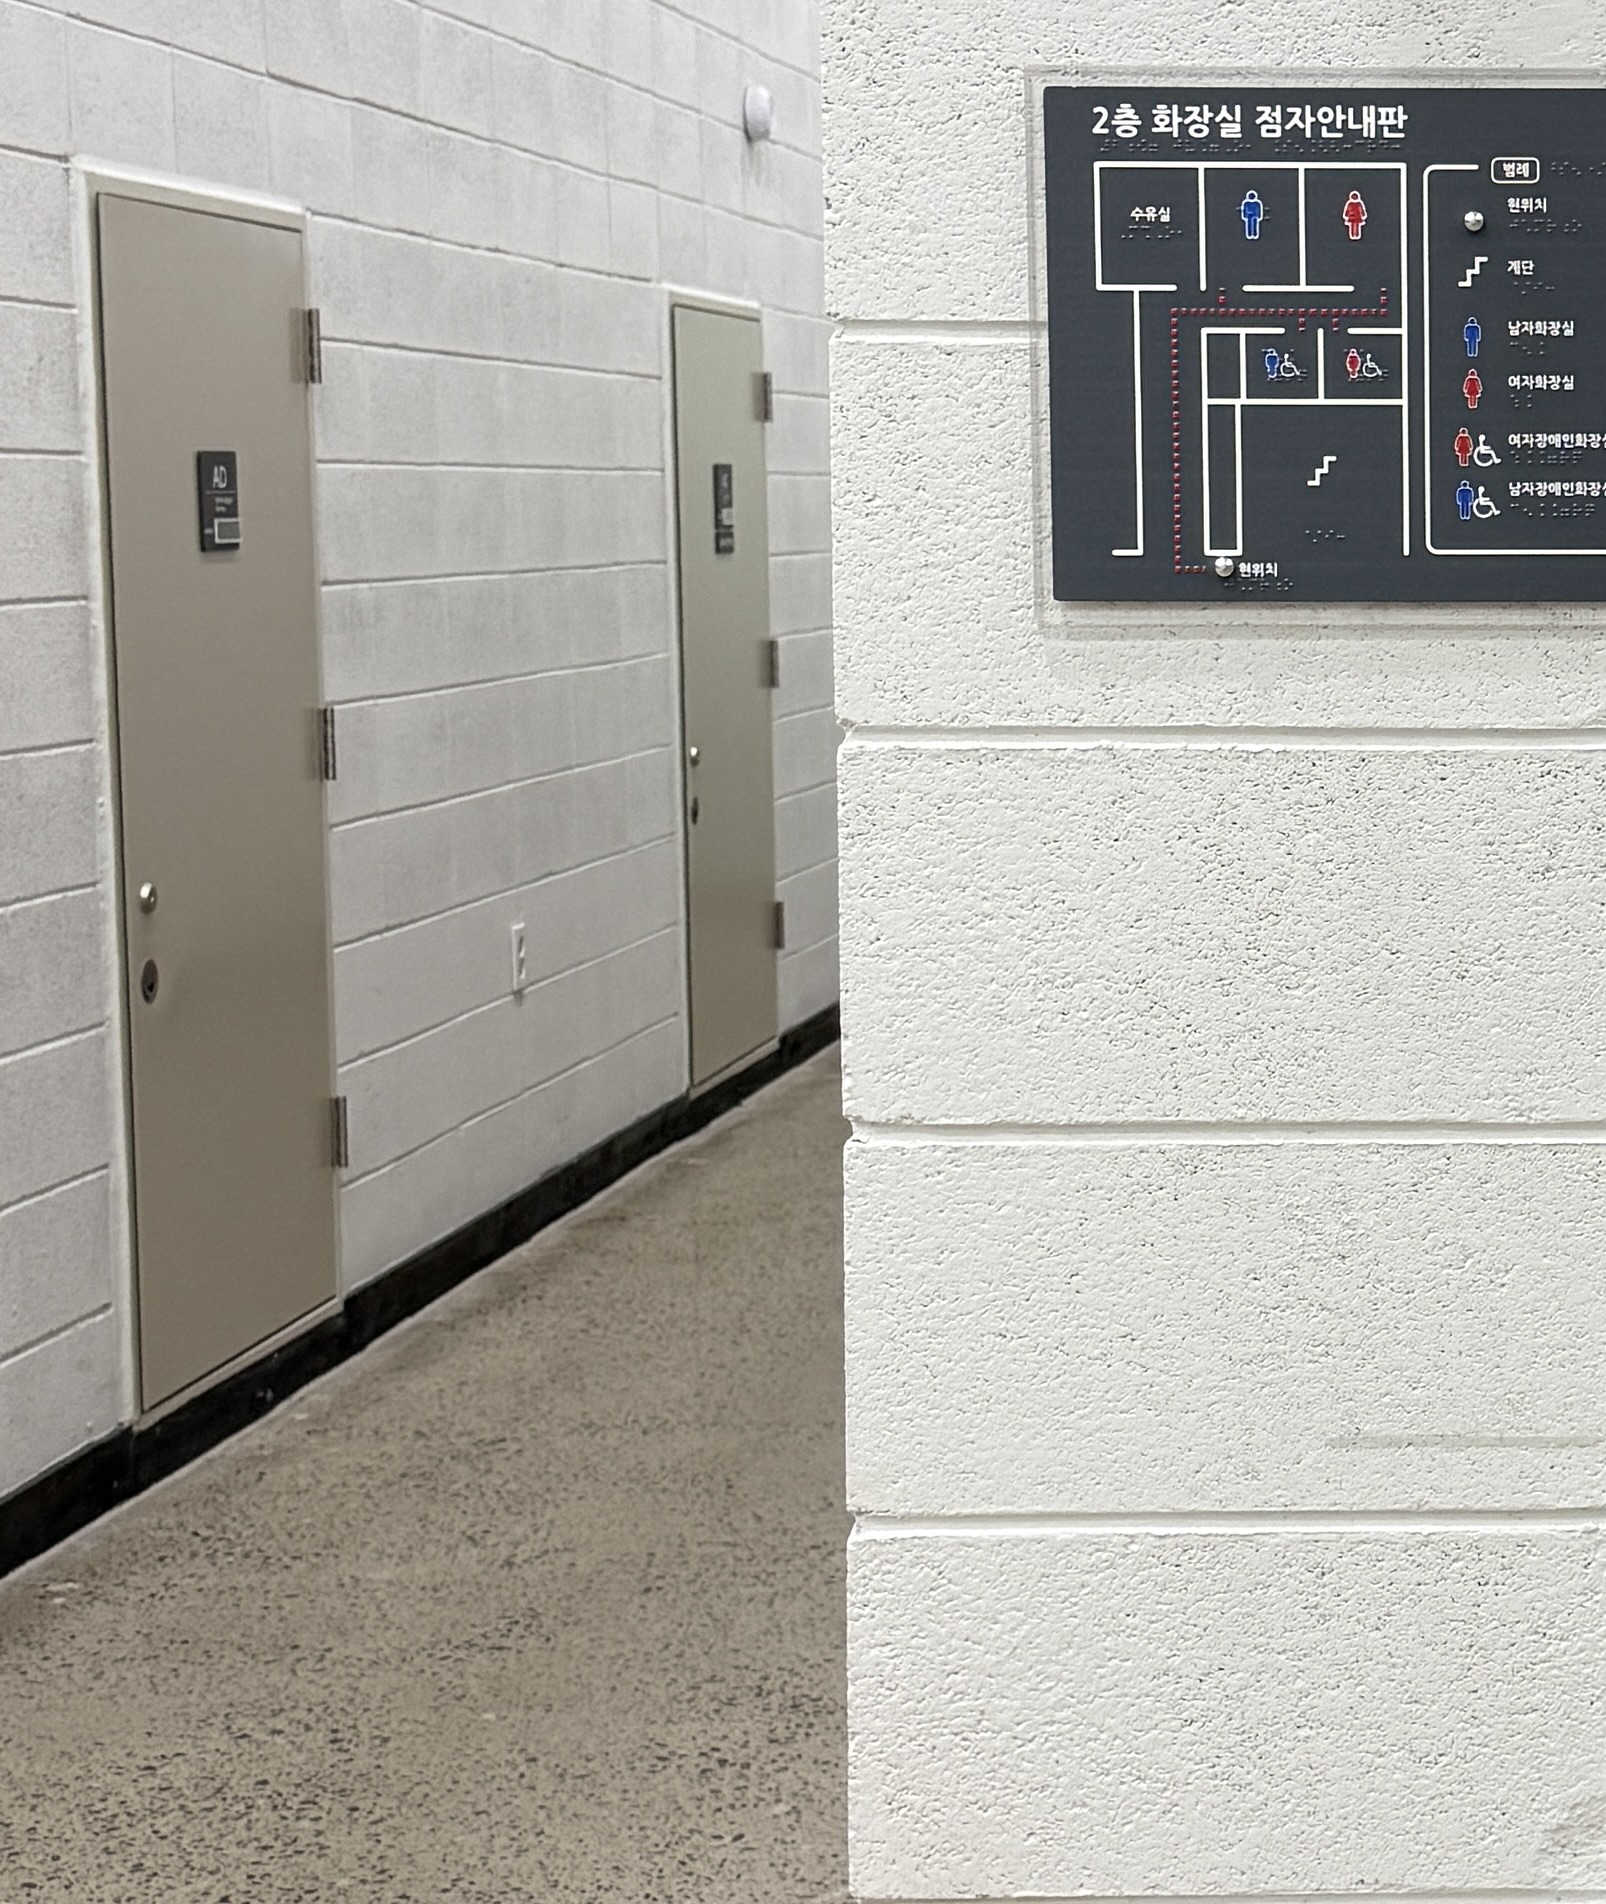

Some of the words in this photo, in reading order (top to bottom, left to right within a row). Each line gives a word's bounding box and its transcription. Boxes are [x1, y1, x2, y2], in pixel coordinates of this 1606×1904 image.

[1092, 103, 1142, 138] 2층
[1152, 104, 1242, 138] 화장실
[1255, 104, 1408, 138] 점자안내판
[1503, 162, 1529, 178] 범례
[1129, 206, 1171, 223] 수유실
[1507, 260, 1535, 275] 계단
[1508, 320, 1574, 336] 남자화장실
[1508, 374, 1574, 390] 여자화장실
